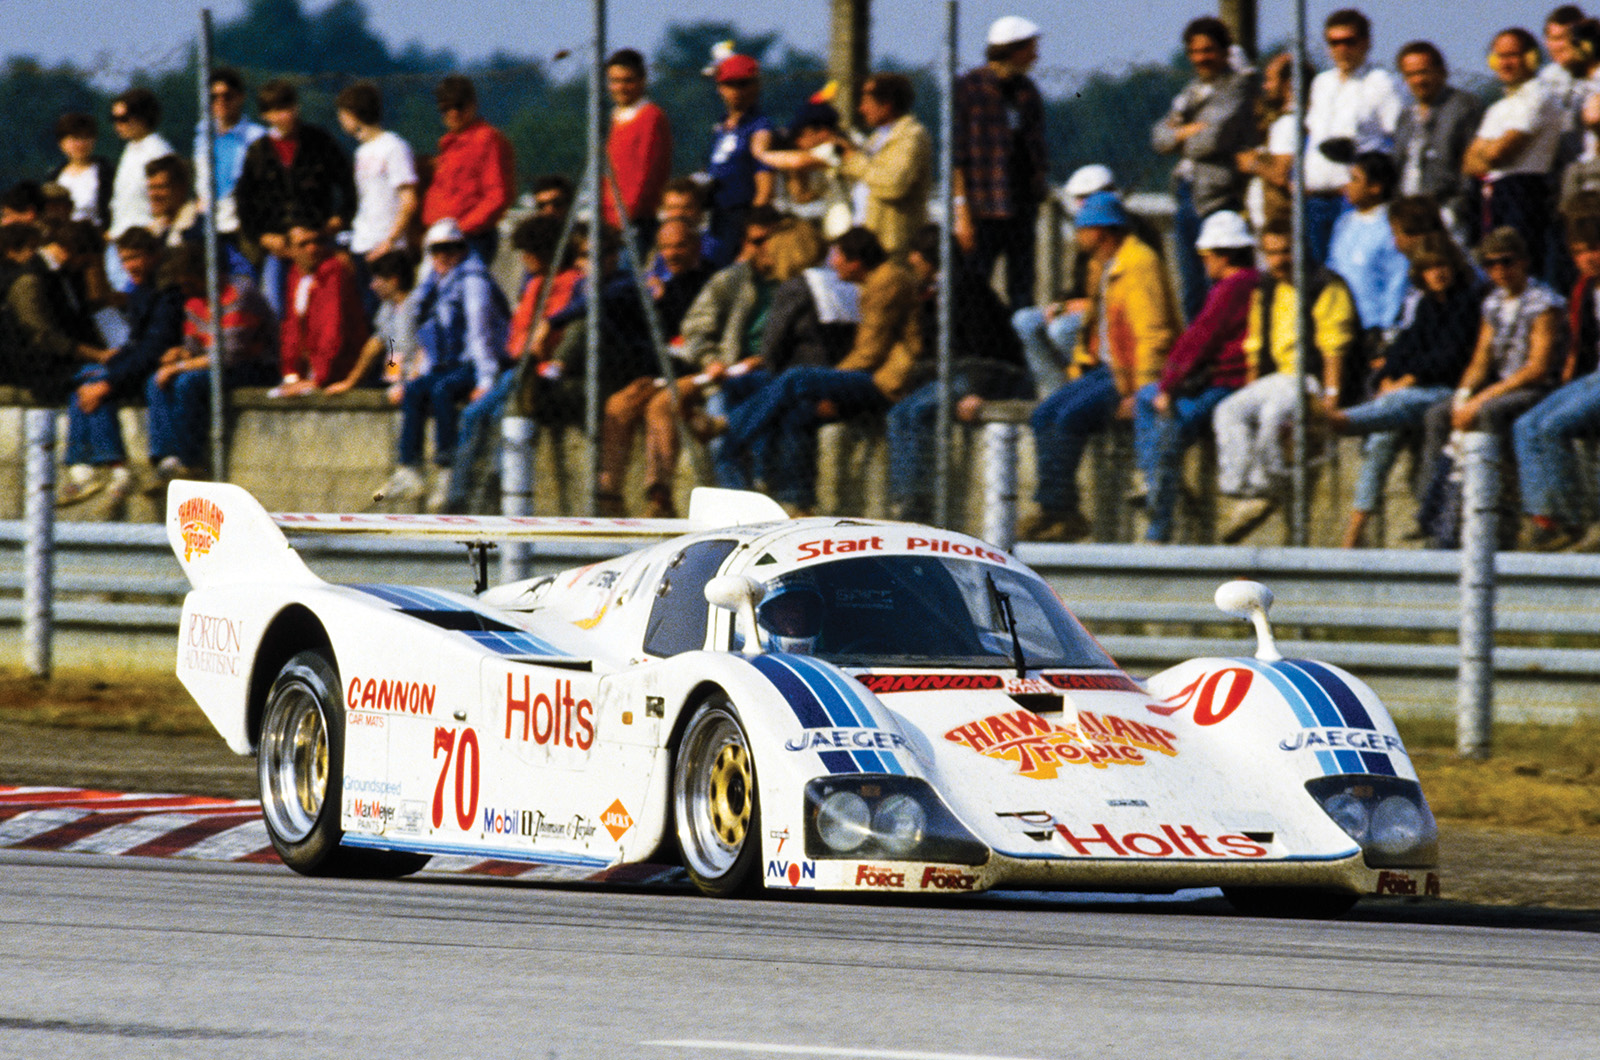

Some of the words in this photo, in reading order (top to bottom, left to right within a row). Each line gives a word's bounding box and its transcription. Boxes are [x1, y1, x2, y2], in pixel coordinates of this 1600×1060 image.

[178, 497, 224, 537] HAWAIIAN
[797, 536, 884, 562] Start
[907, 537, 1006, 564] Pilote
[348, 676, 436, 715] CANNON
[1008, 678, 1043, 687] CAR
[348, 713, 364, 726] CAR
[365, 716, 384, 728] MATS
[505, 672, 594, 751] Holts
[784, 731, 906, 752] JAEGER
[1279, 731, 1407, 756] JAEGER
[343, 775, 402, 796] Groundspeed
[432, 727, 480, 831] 70
[354, 798, 396, 824] MaxMeyer
[484, 807, 518, 834] Mobil
[1054, 824, 1267, 858] Holts
[767, 861, 815, 887] AVON
[856, 865, 905, 887] FORCE
[921, 867, 975, 889] FORCE
